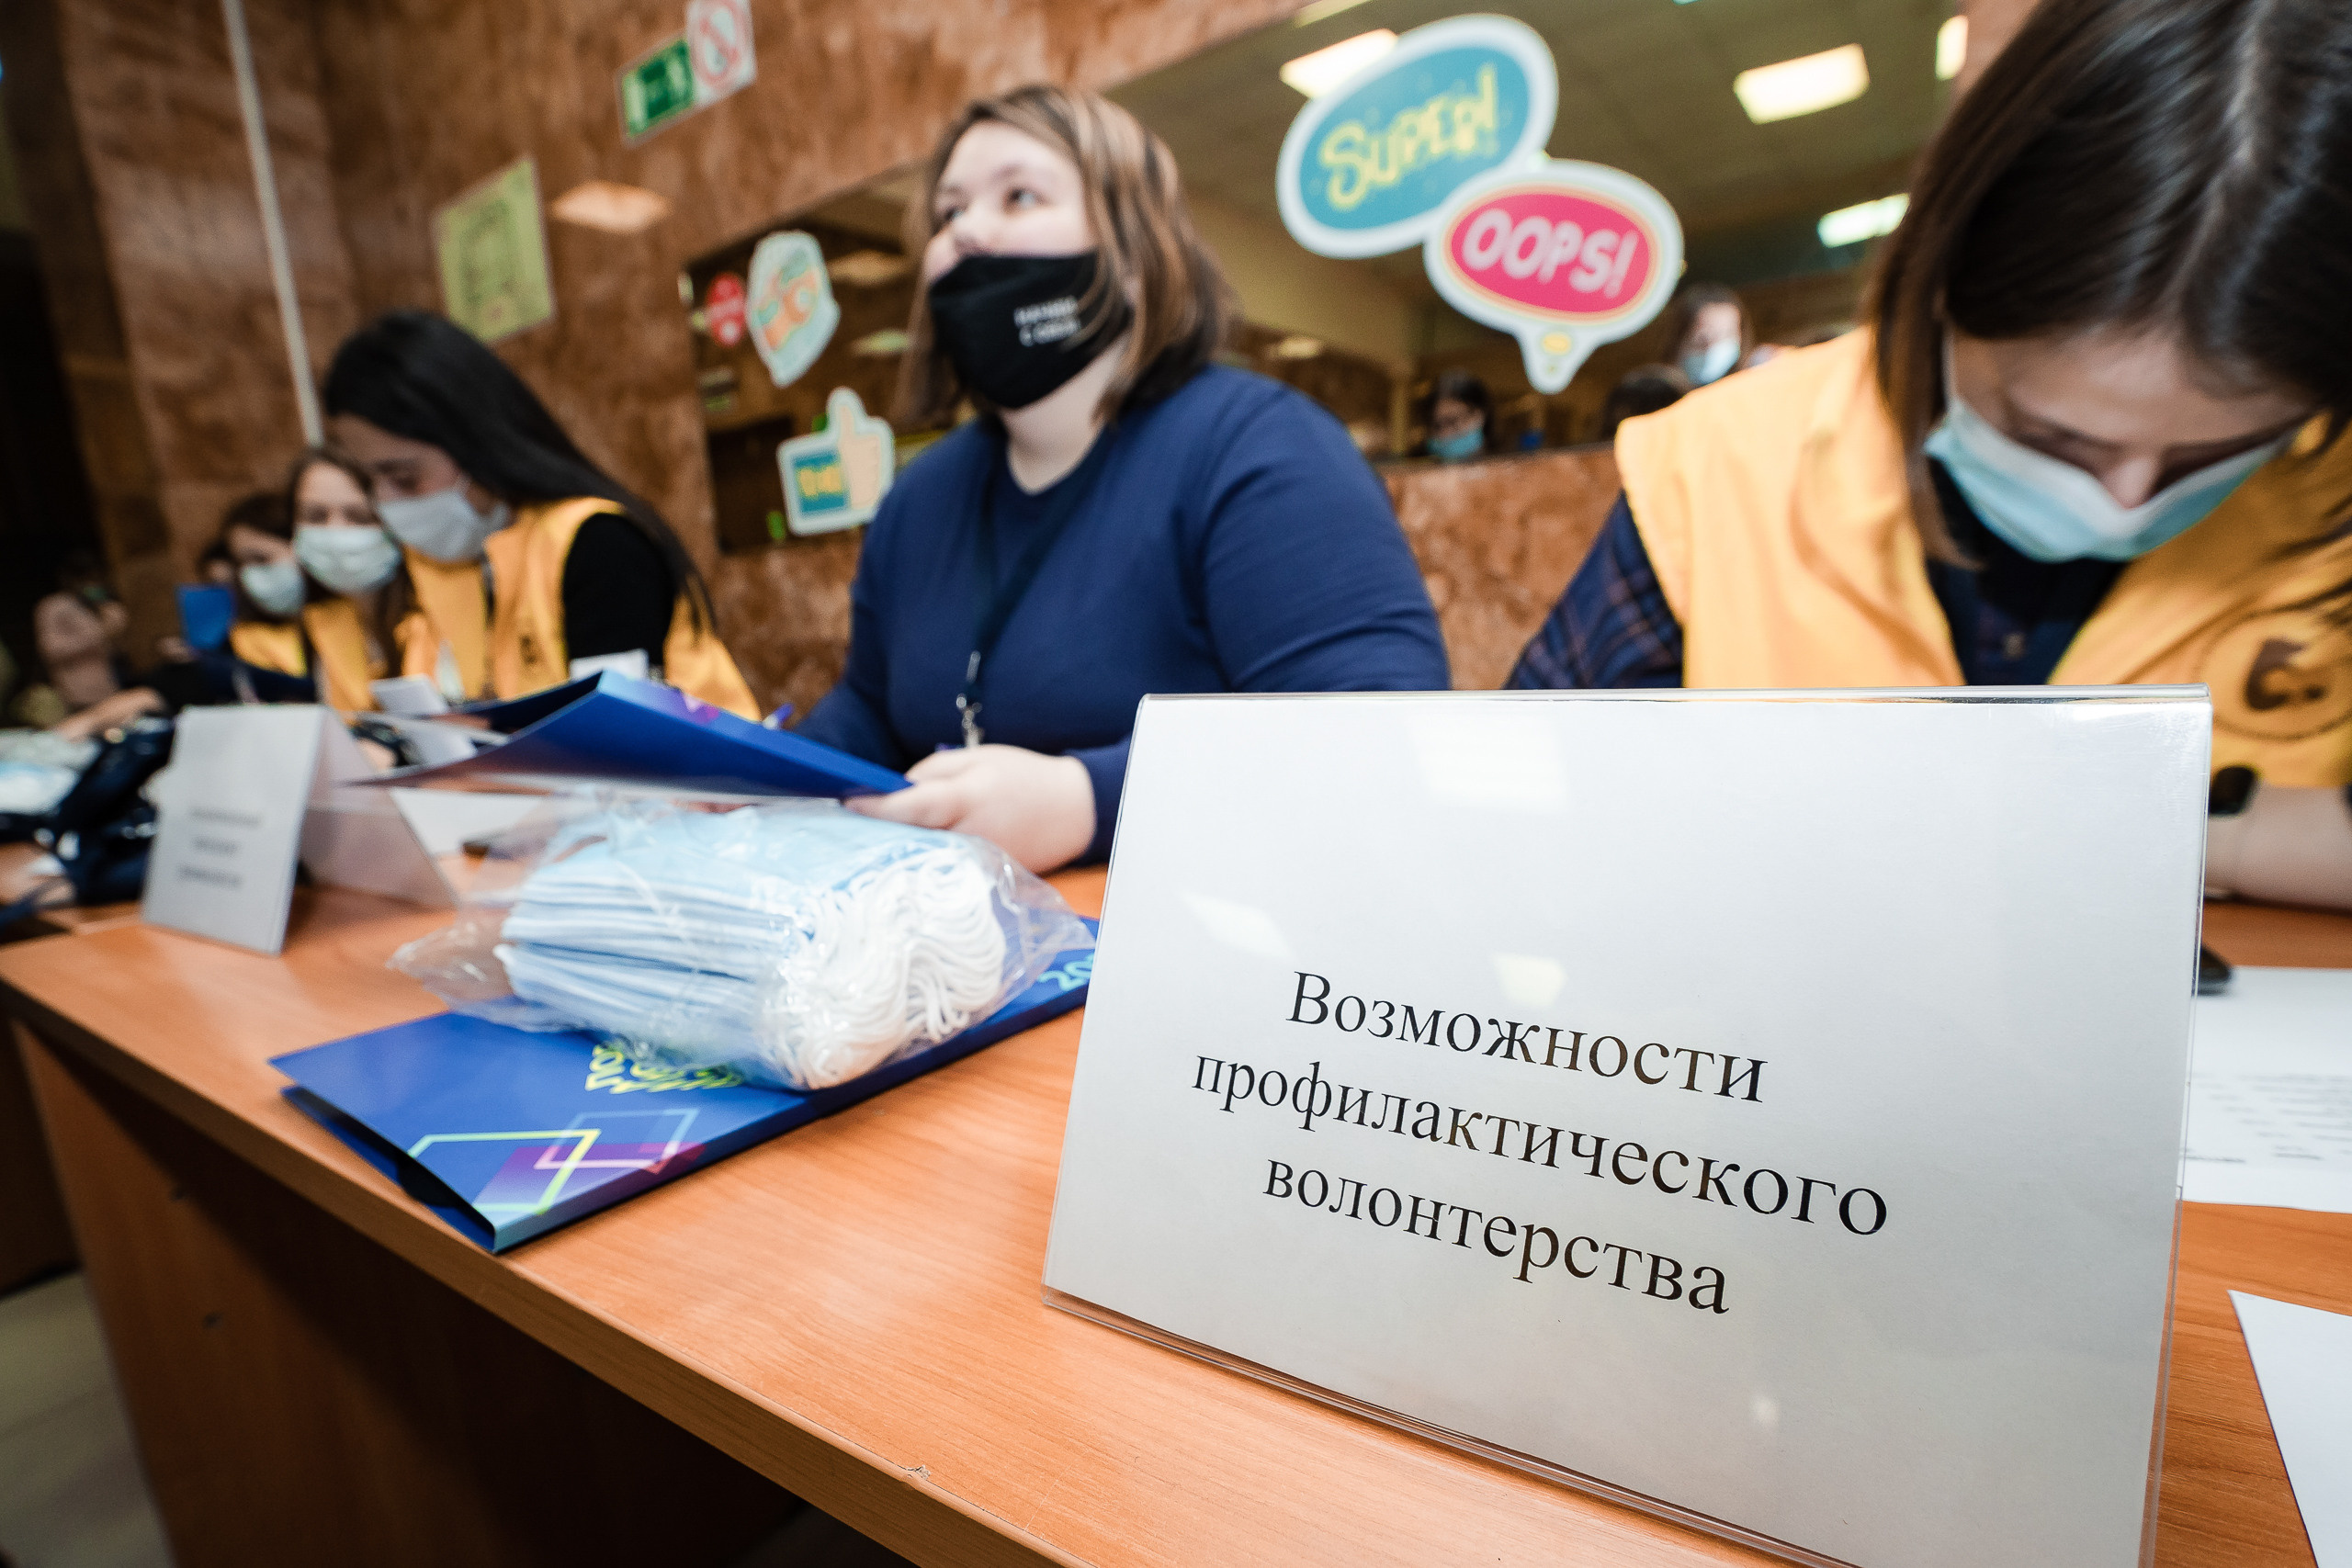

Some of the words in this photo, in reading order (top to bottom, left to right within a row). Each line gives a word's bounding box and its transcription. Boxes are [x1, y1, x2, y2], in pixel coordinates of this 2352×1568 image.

[1317, 62, 1499, 211] SUPER!
[1461, 208, 1640, 299] OOPS!
[1285, 970, 1769, 1103] Возможности
[1191, 1055, 1887, 1235] профилактического
[1261, 1158, 1730, 1314] волонтерства
